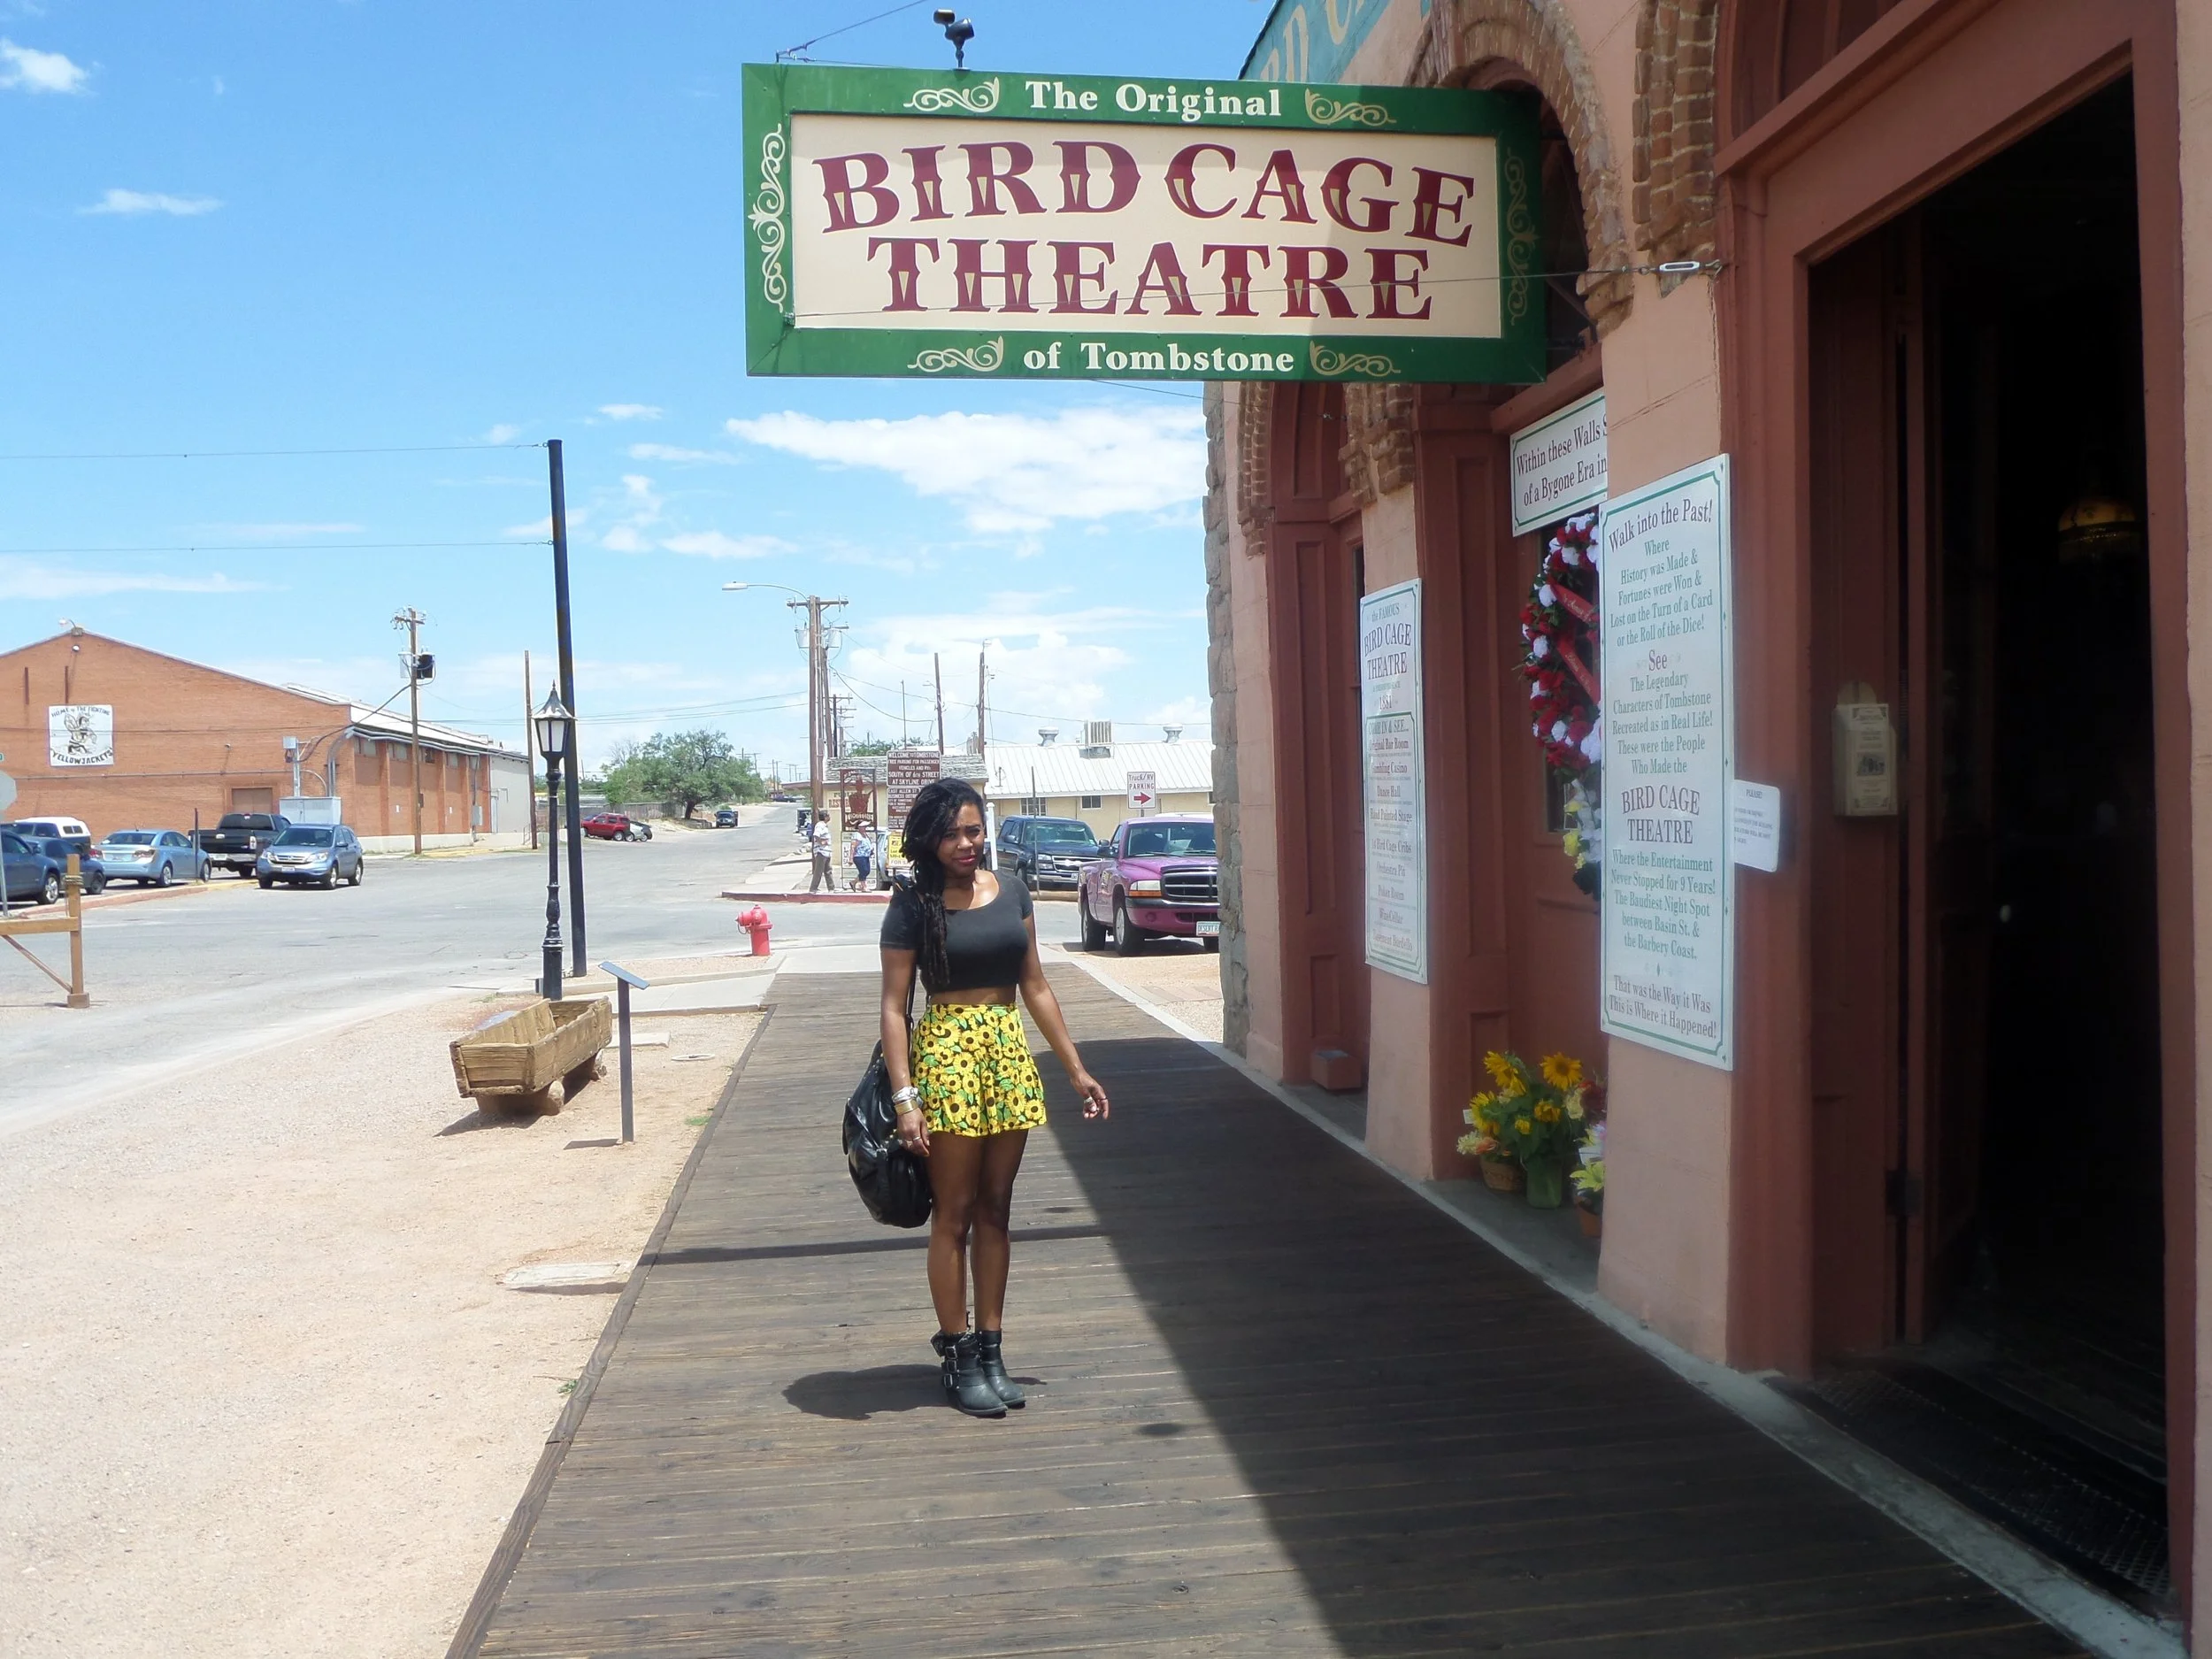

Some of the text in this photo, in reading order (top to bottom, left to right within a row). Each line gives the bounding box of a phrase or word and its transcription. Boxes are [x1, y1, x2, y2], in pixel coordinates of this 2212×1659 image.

[1025, 81, 1281, 122] The Original
[811, 139, 1476, 249] BIRD CAGE
[865, 236, 1432, 321] THEATRE
[1024, 342, 1294, 372] of Tombstone
[1517, 447, 1546, 476] Within
[1548, 438, 1572, 462] these
[1573, 420, 1601, 449] Walls
[1524, 483, 1533, 506] of
[1534, 487, 1540, 503] a
[1541, 472, 1575, 501] Bygone
[1578, 461, 1594, 484] Era
[1609, 499, 1713, 553] Walk into the Past!
[1645, 539, 1670, 557] Where
[1621, 549, 1698, 585] History was Made &
[1618, 570, 1701, 606] Fortunes were Won &
[1610, 589, 1713, 628] Lost on the Turn of a Card
[1364, 623, 1411, 657] BIRD CAGE
[1617, 613, 1704, 647] or the Roll of the Dice!
[1367, 652, 1407, 680] THEATRE
[1648, 649, 1668, 671] See
[1631, 672, 1688, 693] The Legendary
[1613, 692, 1711, 715] Characters of Tombstone
[1612, 710, 1713, 735] Recreated as in Real Life!
[1617, 733, 1705, 755] These were the People
[1391, 762, 1407, 773] Casino
[1632, 757, 1687, 774] Who Made the
[1621, 784, 1700, 815] BIRD CAGE
[1627, 818, 1693, 844] THEATRE
[1612, 849, 1713, 872] Where the Entertainment
[1611, 869, 1632, 885] Never
[1633, 871, 1664, 889] Stopped
[1666, 875, 1678, 891] for
[1687, 877, 1716, 895] Years!
[1614, 889, 1628, 905] The
[1664, 895, 1687, 915] Night
[1689, 899, 1710, 918] Spot
[1622, 911, 1700, 938] between Basin St. &
[1624, 933, 1697, 960] the Barbery Coast.
[1614, 975, 1710, 1014] That was the Way it Was
[1609, 995, 1717, 1039] This is Where it Happened!
